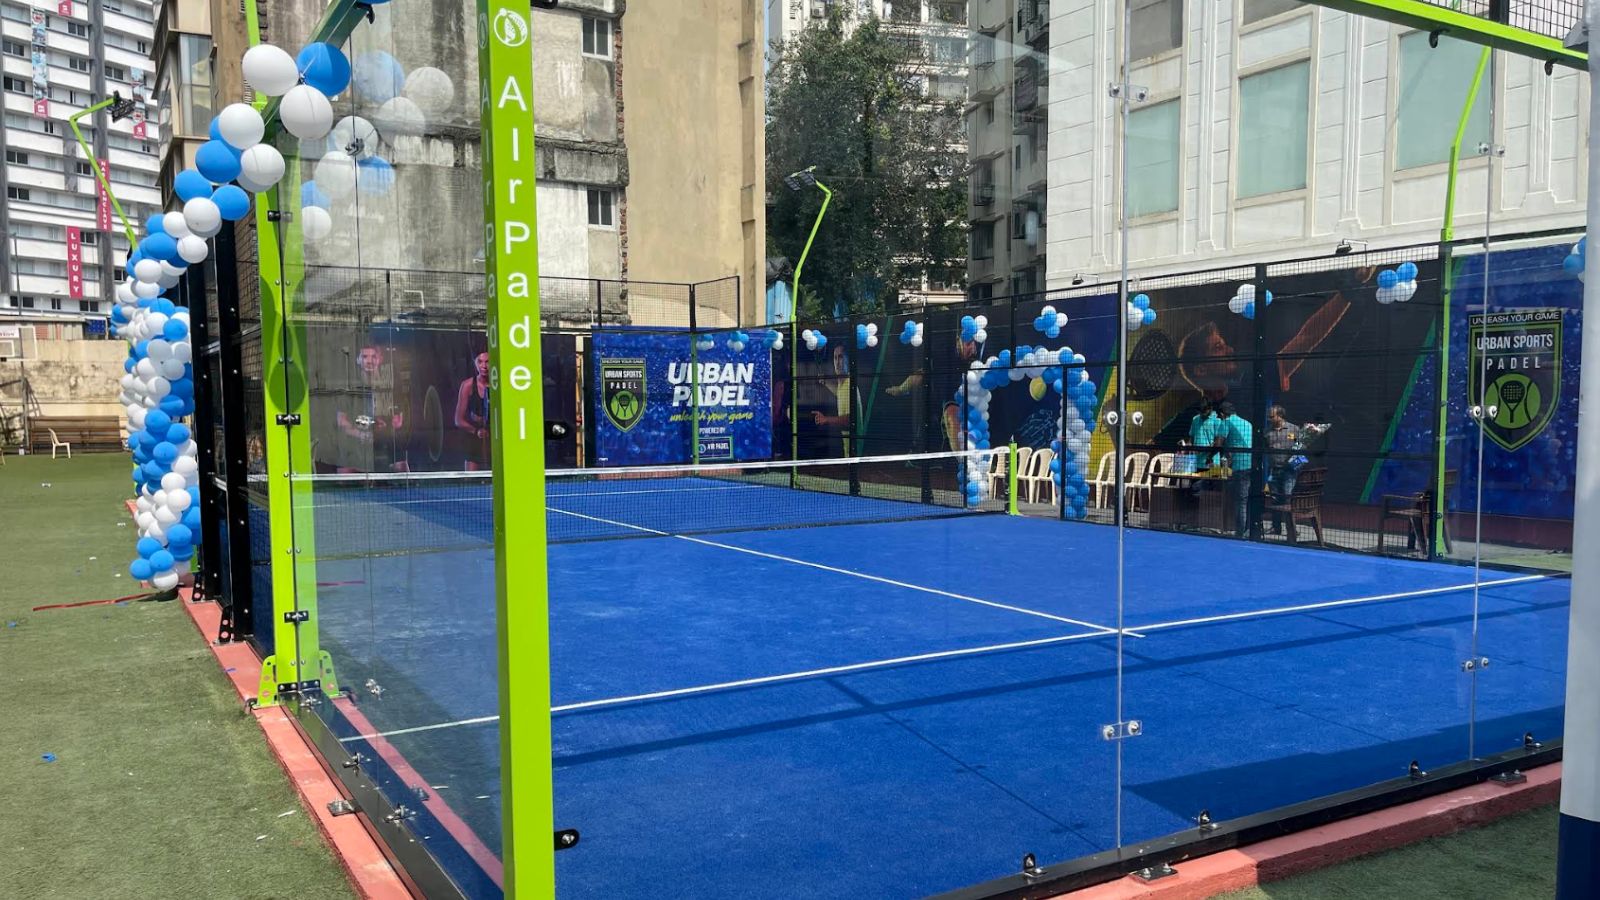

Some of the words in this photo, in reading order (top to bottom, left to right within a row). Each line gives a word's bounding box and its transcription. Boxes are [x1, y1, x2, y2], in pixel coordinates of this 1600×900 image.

[70, 232, 79, 293] LUXURY
[1511, 314, 1533, 322] YOUR
[1535, 312, 1559, 320] GAME
[1477, 335, 1511, 350] URBAN
[1513, 334, 1553, 348] SPORTS
[1486, 356, 1541, 370] PADEL
[605, 370, 623, 378] URBAN
[623, 370, 642, 378] SPORTS
[668, 362, 754, 384] URBAN
[672, 385, 750, 407] PADEL
